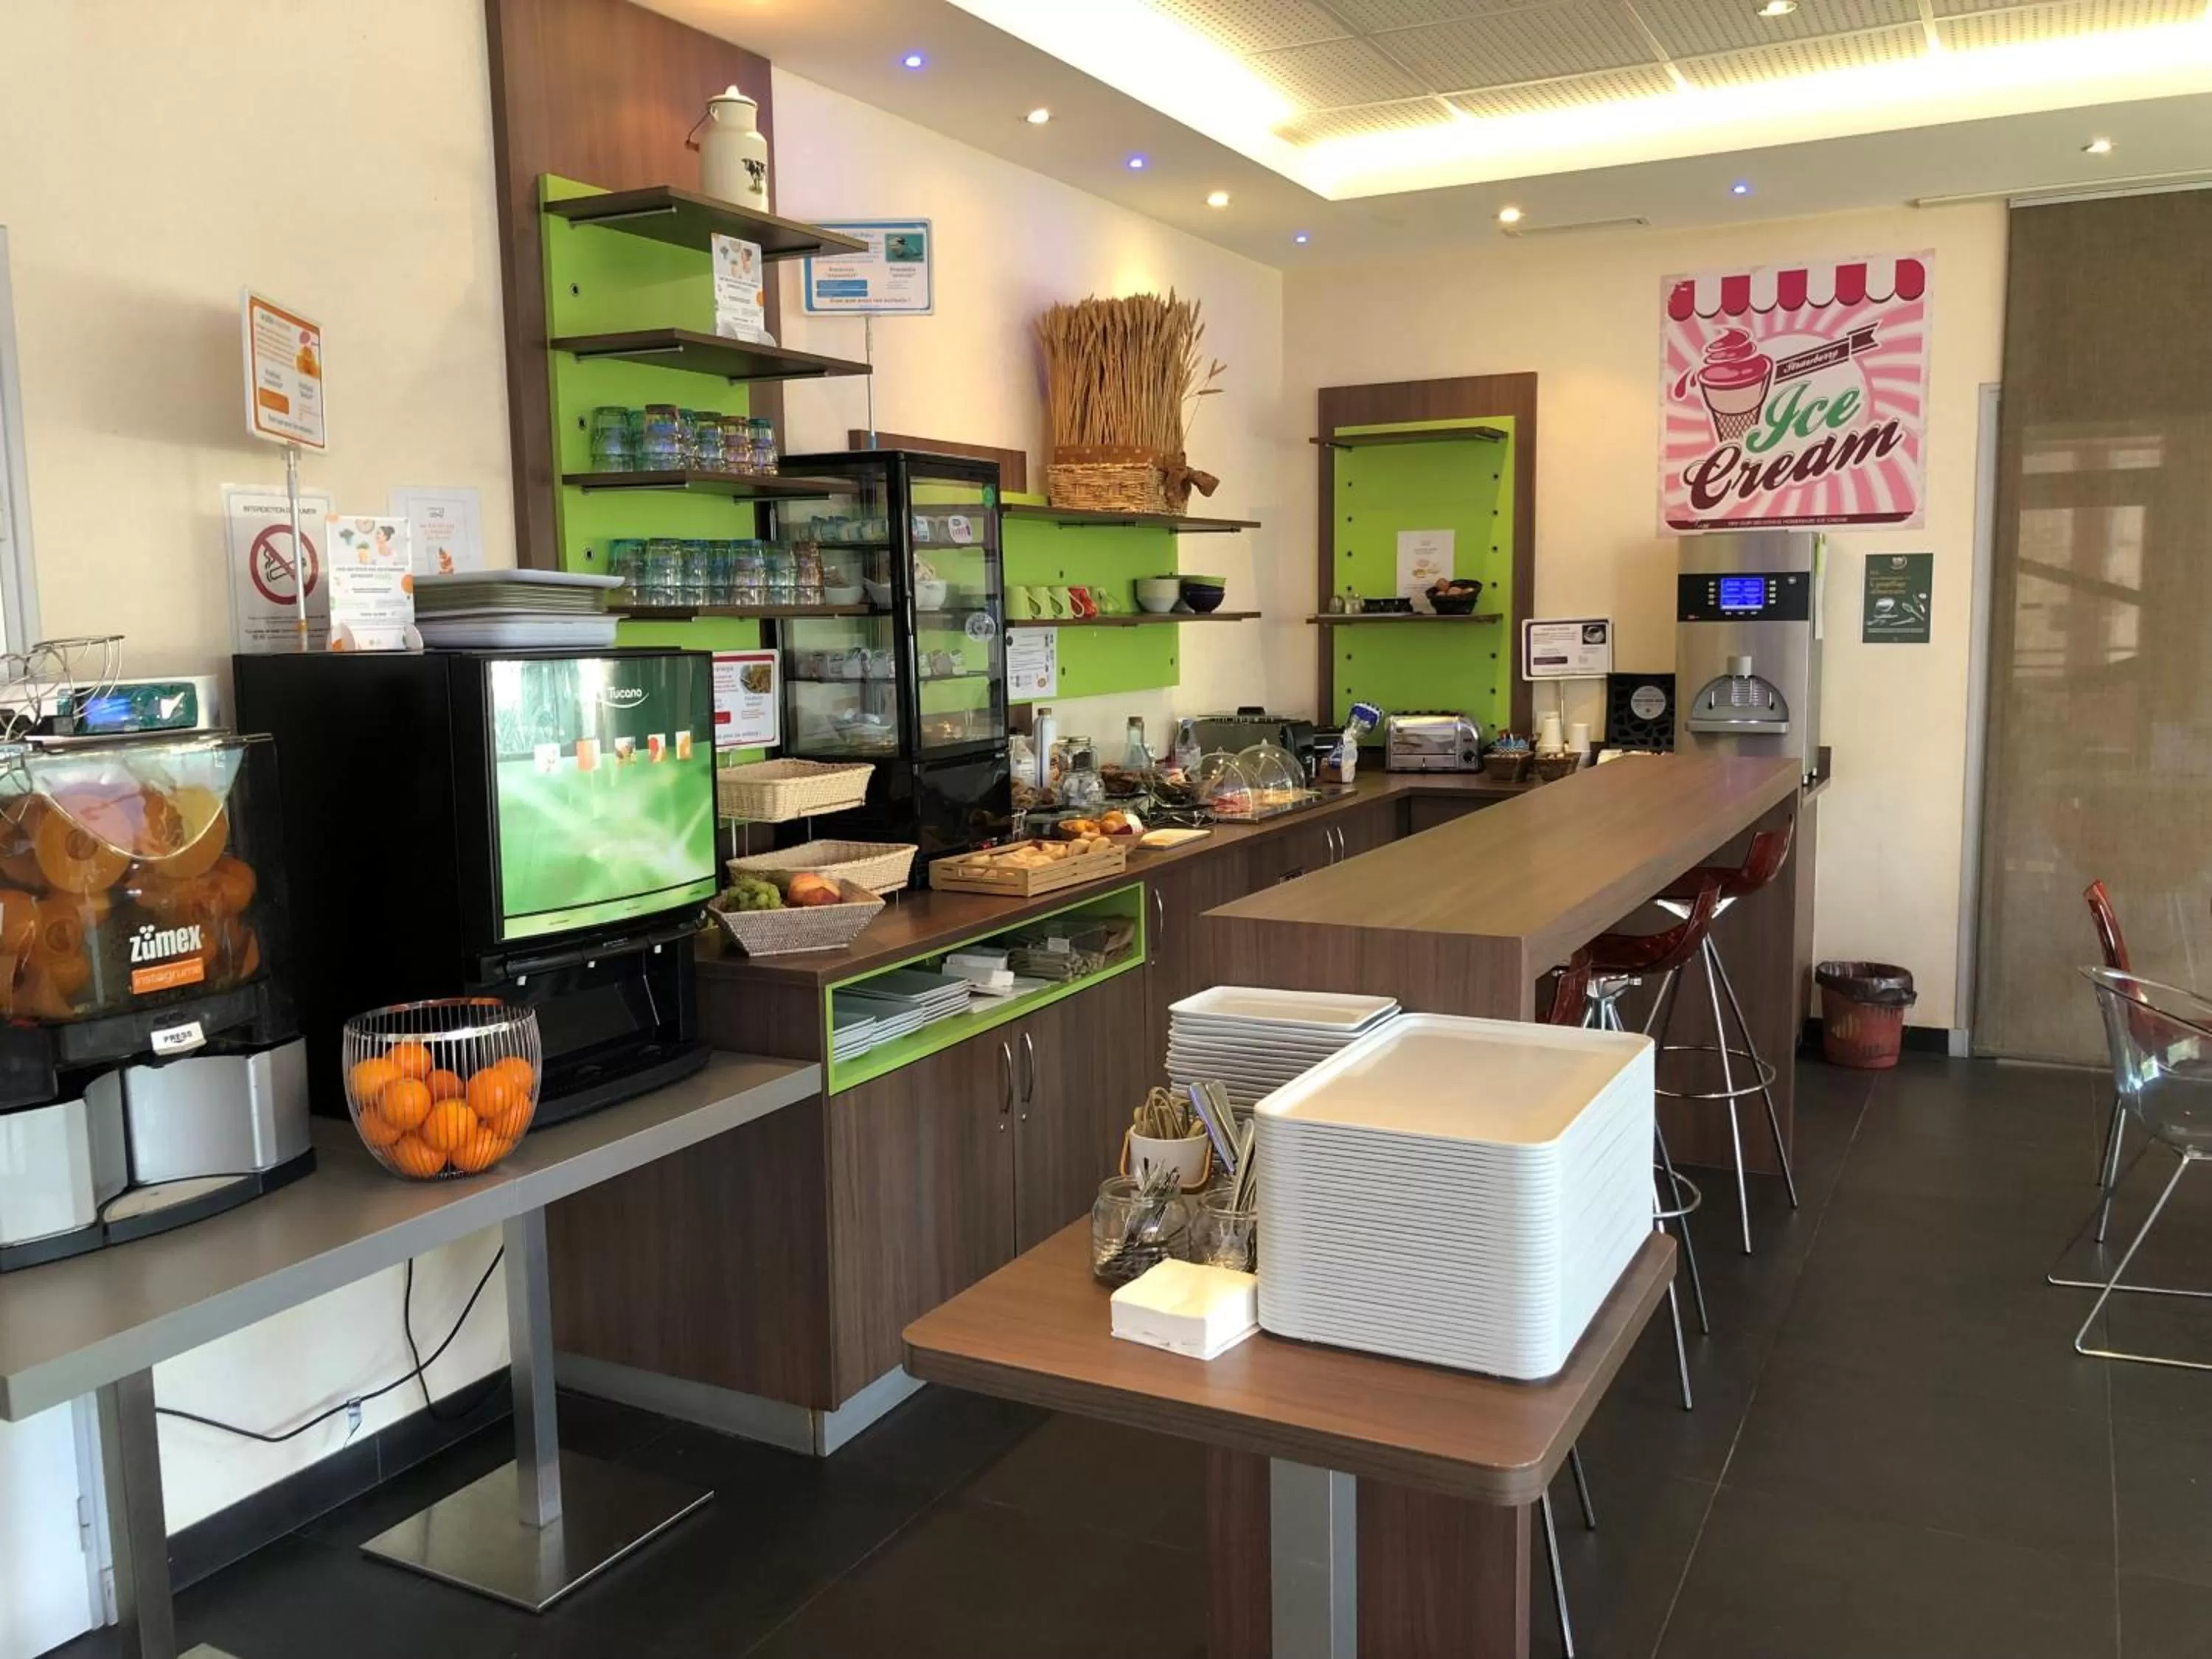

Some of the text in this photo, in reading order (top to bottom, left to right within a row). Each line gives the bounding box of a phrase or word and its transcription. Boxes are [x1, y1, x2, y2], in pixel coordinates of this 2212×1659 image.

[1784, 349, 1839, 373] Strawberry
[1745, 380, 1862, 453] Ice
[1683, 416, 1903, 510] Cream
[607, 686, 642, 699] Tucano
[163, 1030, 192, 1043] PRESS
